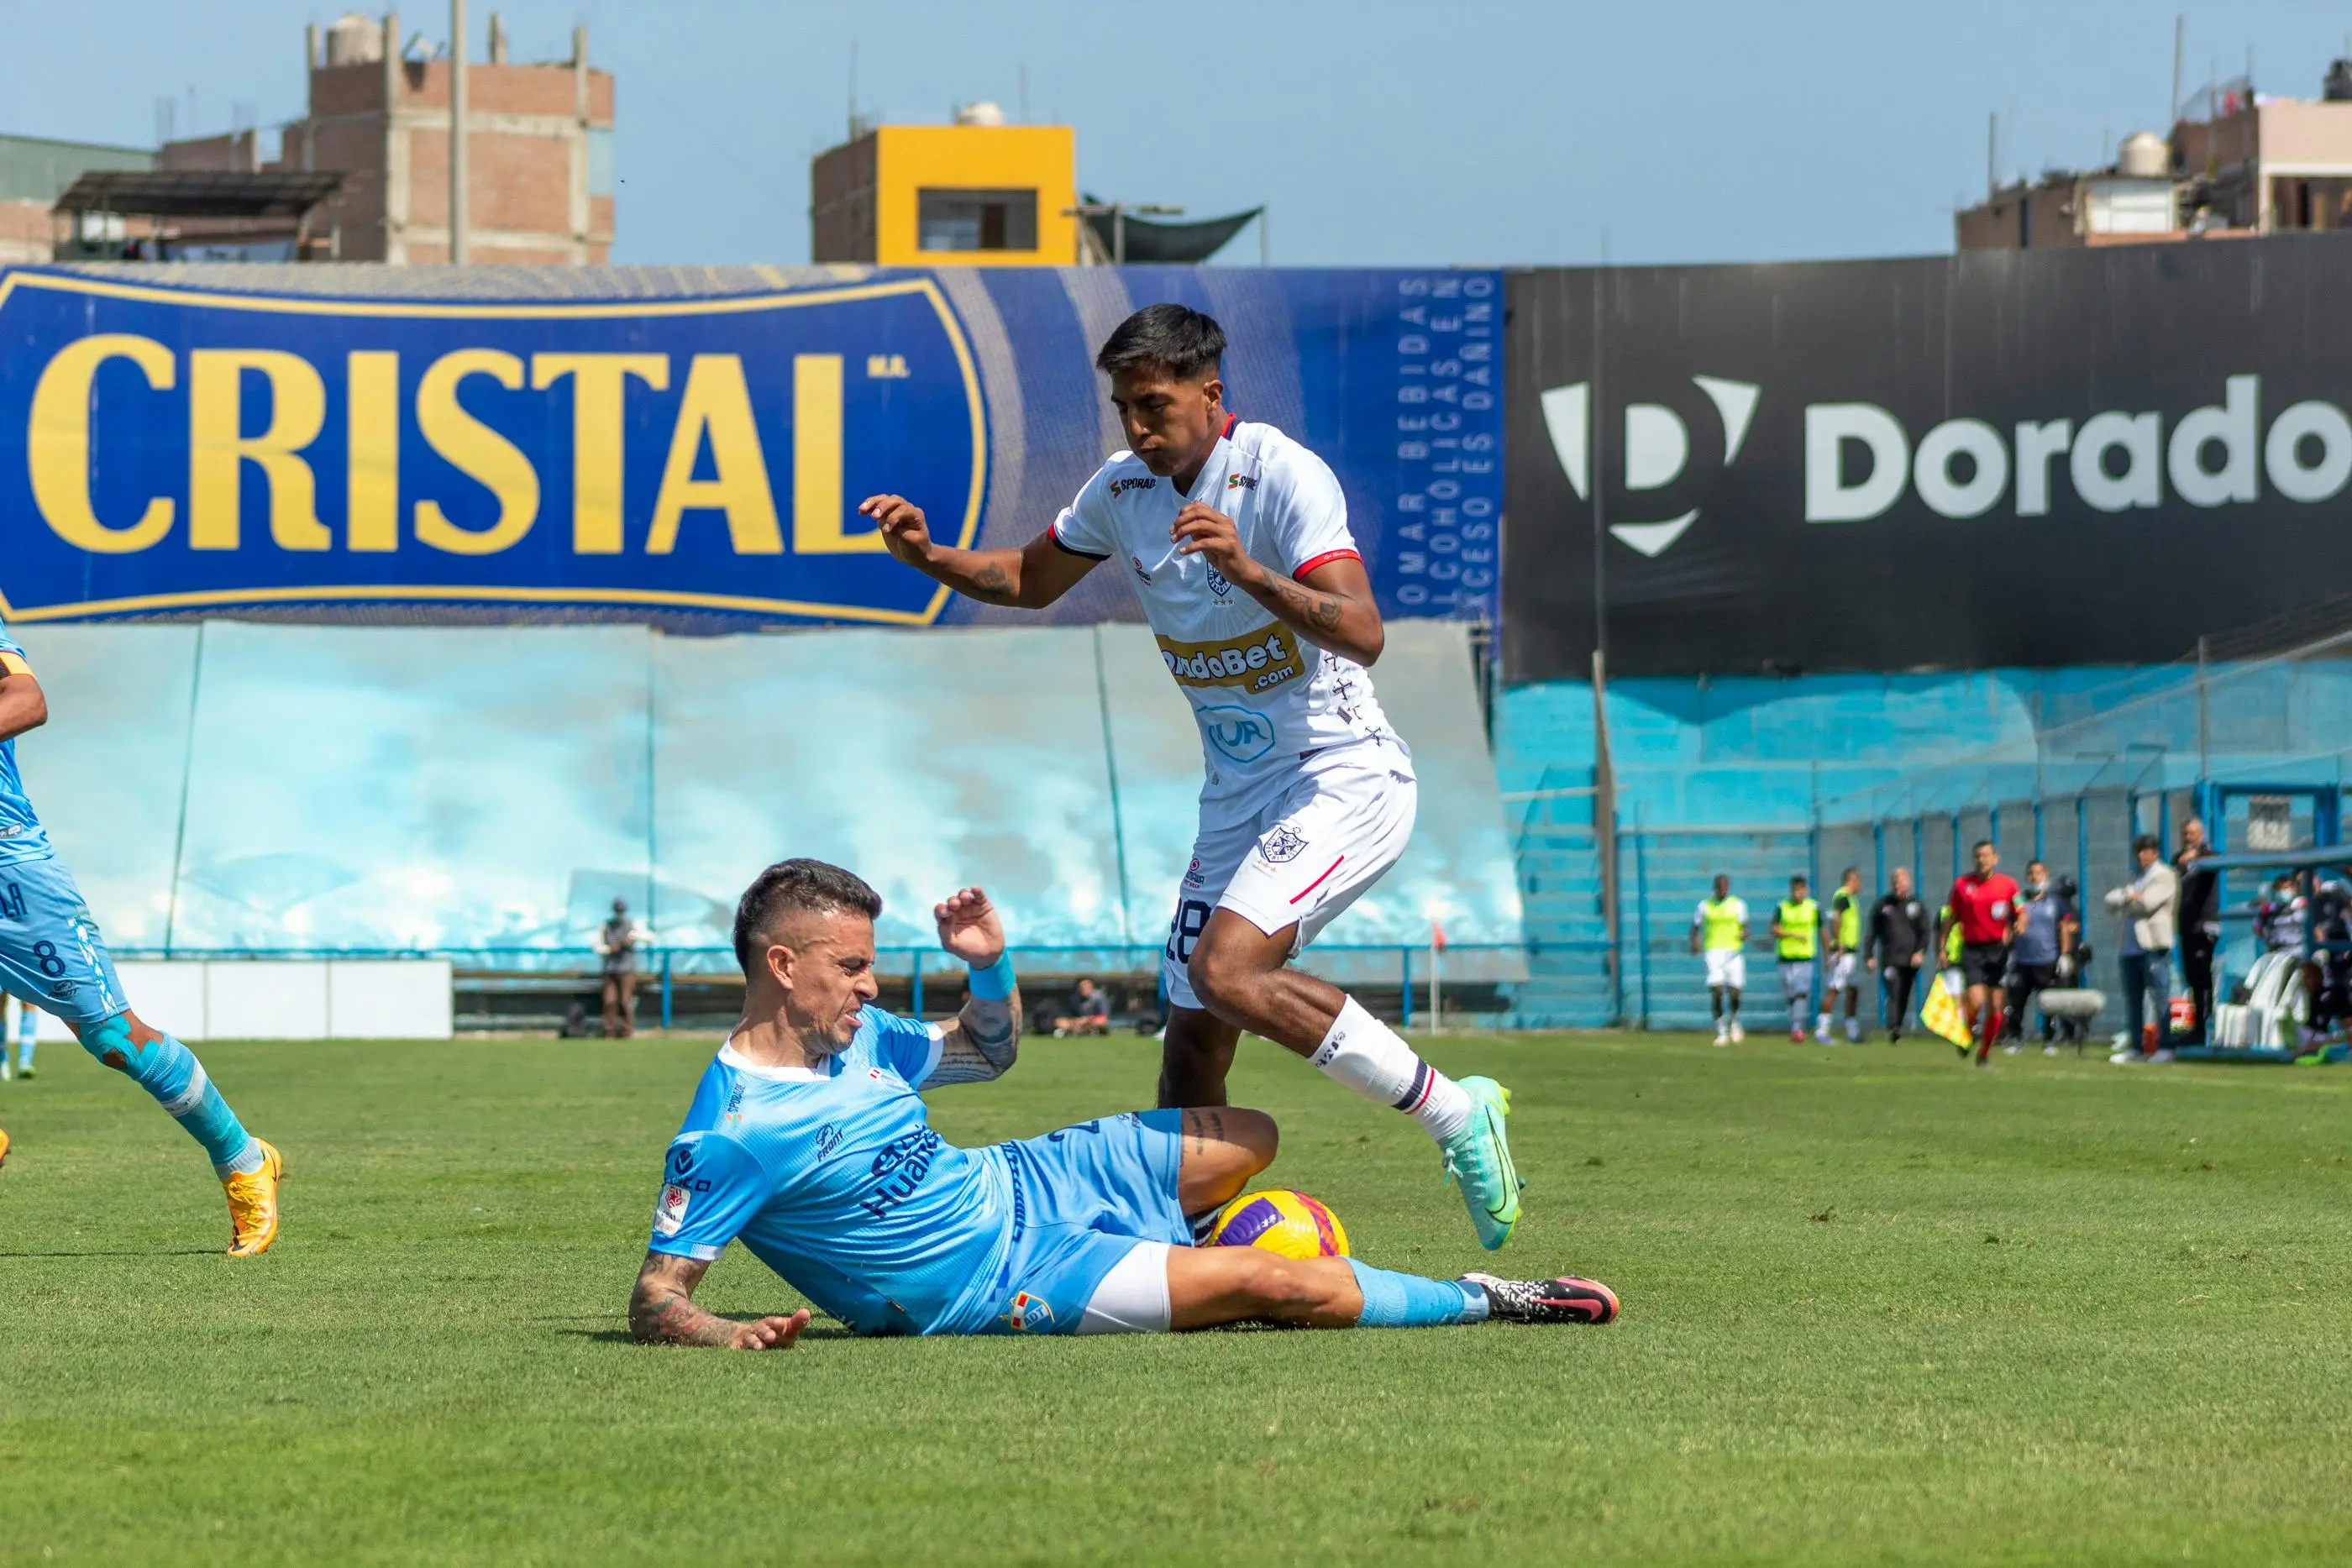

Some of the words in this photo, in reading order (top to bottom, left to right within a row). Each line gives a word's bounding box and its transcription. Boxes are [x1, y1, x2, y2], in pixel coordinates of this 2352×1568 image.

[1430, 278, 1462, 333] EN
[1458, 276, 1495, 411] DAÑINO
[1397, 277, 1430, 460] BEBIDAS
[28, 333, 895, 555] CRISTAL
[1462, 433, 1494, 474] ES
[1804, 375, 2352, 523] Dorado
[1253, 665, 1294, 690] .com
[34, 941, 66, 977] 8
[816, 1129, 843, 1162] FRONT
[1024, 1307, 1044, 1326] ADT
